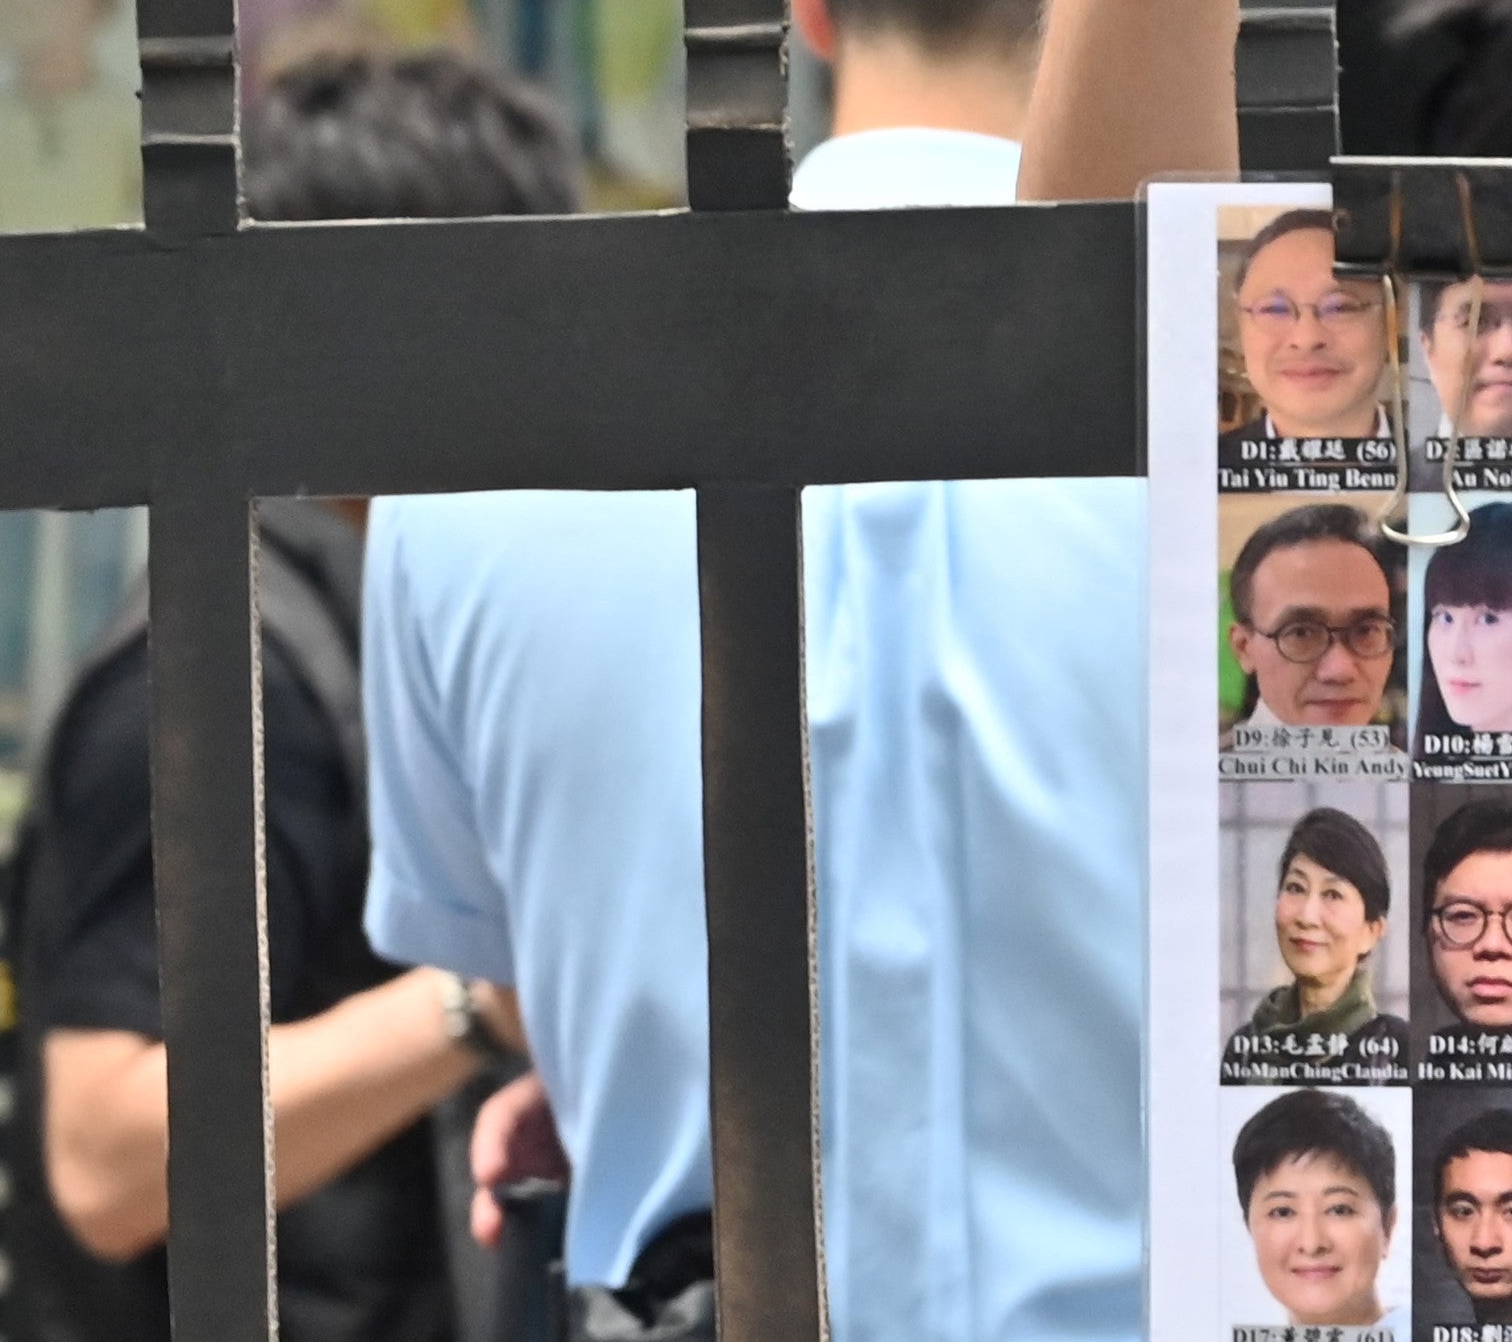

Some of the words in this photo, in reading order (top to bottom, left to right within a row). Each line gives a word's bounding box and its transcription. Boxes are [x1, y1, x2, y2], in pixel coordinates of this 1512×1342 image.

[1357, 441, 1395, 460] (56)
[1219, 468, 1250, 487] Tai
[1254, 468, 1288, 487] Yiu
[1294, 468, 1340, 491] Ting
[1351, 730, 1388, 749] (53)
[1219, 758, 1265, 776] Chui
[1272, 758, 1307, 776] Chi
[1315, 758, 1349, 776] Kin
[1356, 759, 1406, 779] Andy
[1419, 1064, 1447, 1080] Ho
[1451, 1064, 1481, 1080] Kai
